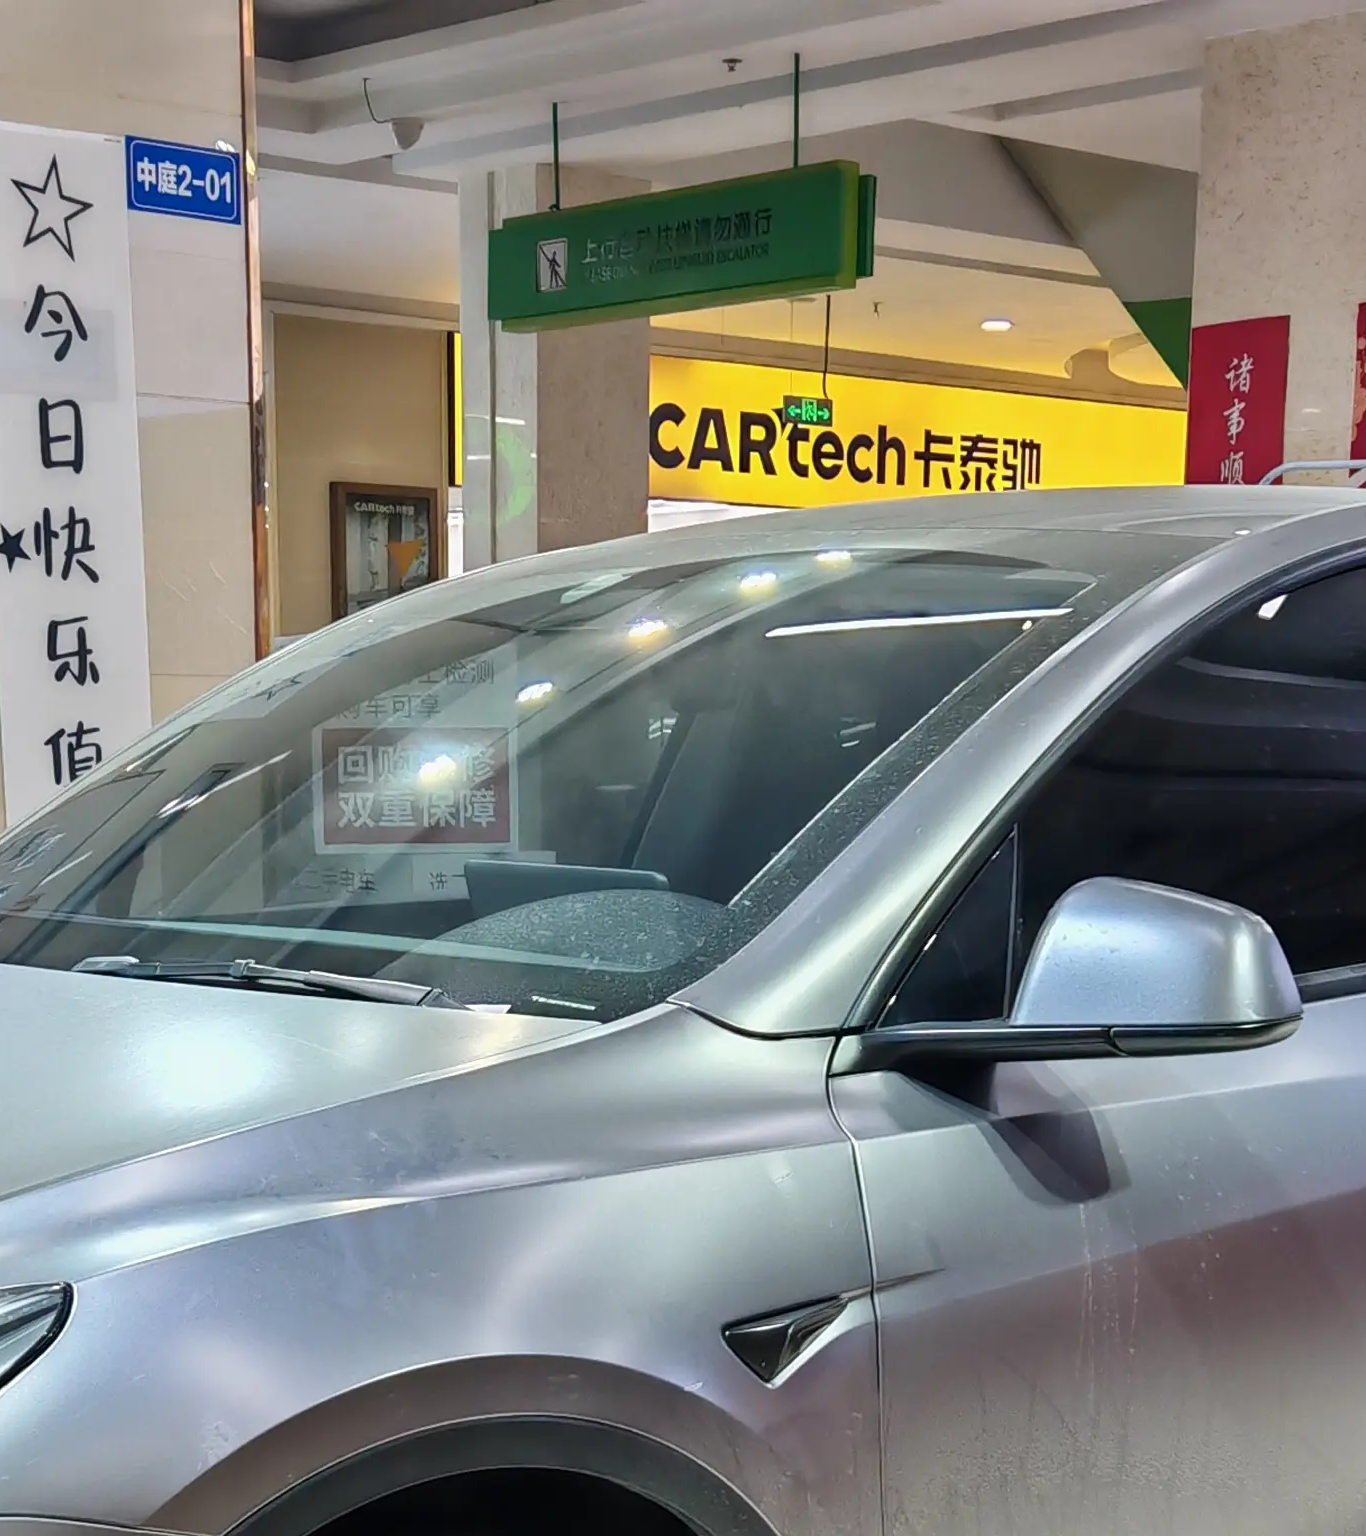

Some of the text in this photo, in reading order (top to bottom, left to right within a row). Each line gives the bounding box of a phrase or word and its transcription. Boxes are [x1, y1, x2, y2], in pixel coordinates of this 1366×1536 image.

[136, 156, 233, 204] 中庭2-01
[649, 402, 1042, 491] CARtech 卡泰驰
[338, 785, 497, 828] 双重保障
